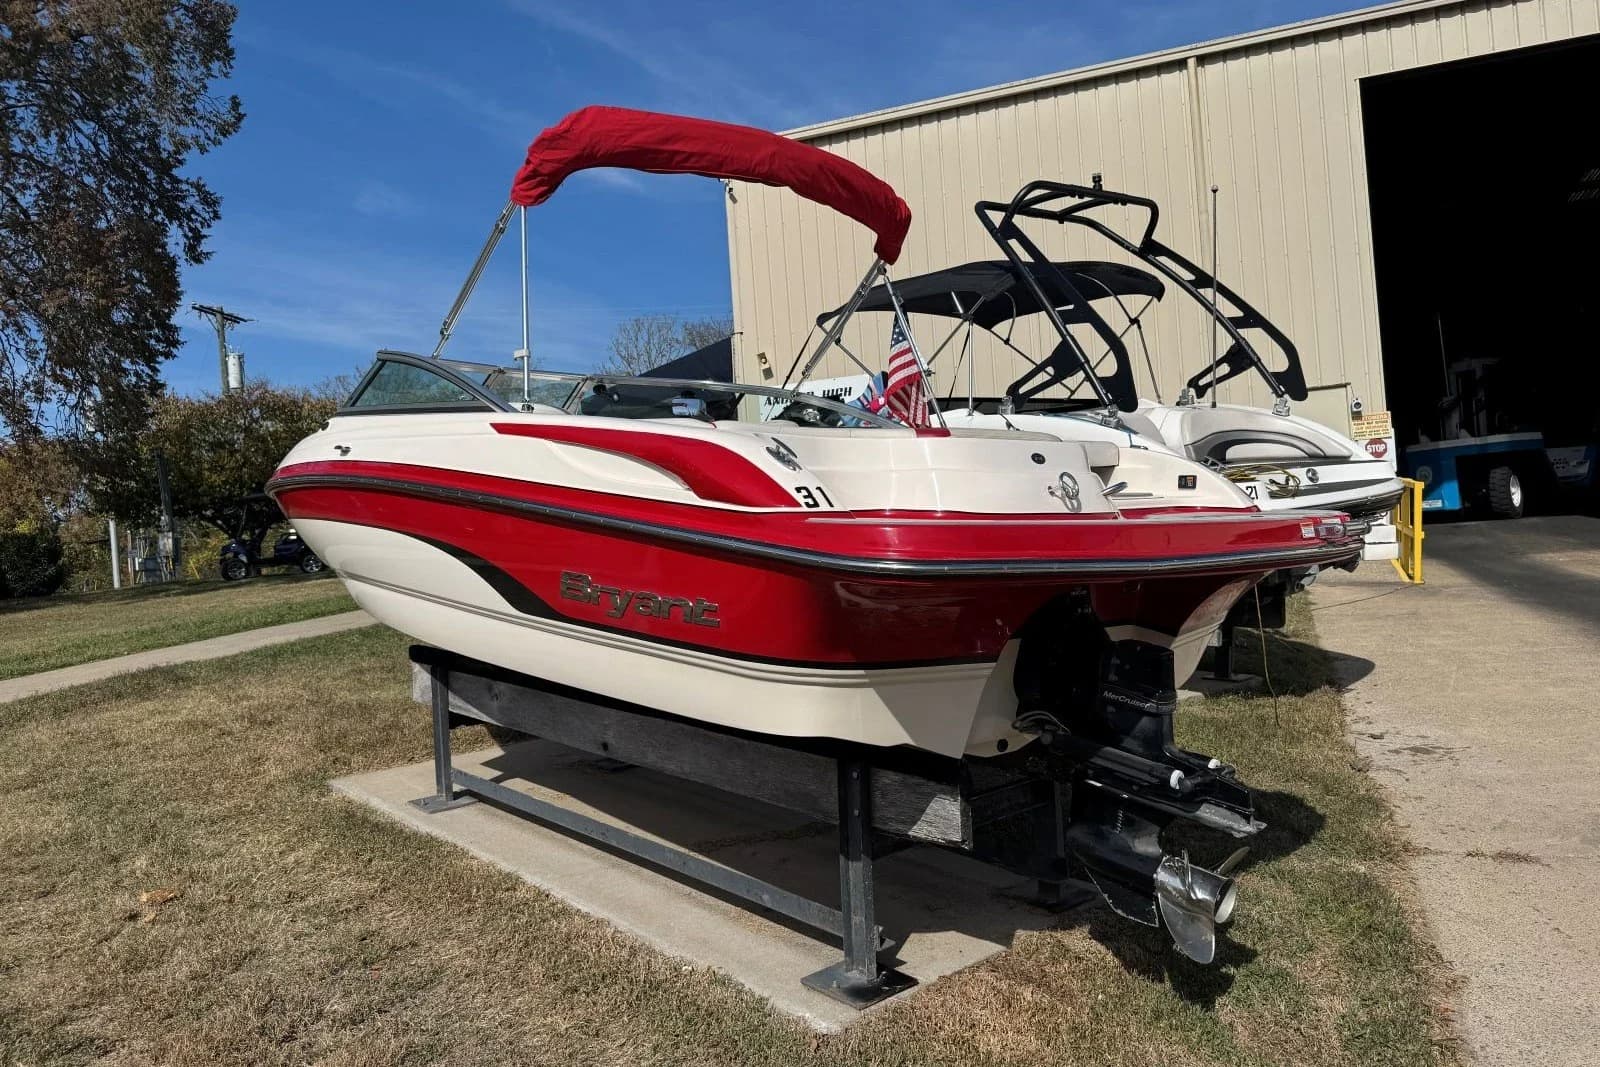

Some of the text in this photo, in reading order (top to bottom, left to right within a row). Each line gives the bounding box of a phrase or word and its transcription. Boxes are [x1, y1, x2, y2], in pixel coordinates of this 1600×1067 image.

[1366, 443, 1386, 453] STOP
[794, 485, 834, 508] 31
[1245, 485, 1259, 500] 21
[560, 570, 720, 628] Bryant
[1103, 690, 1150, 710] MerCruiser
